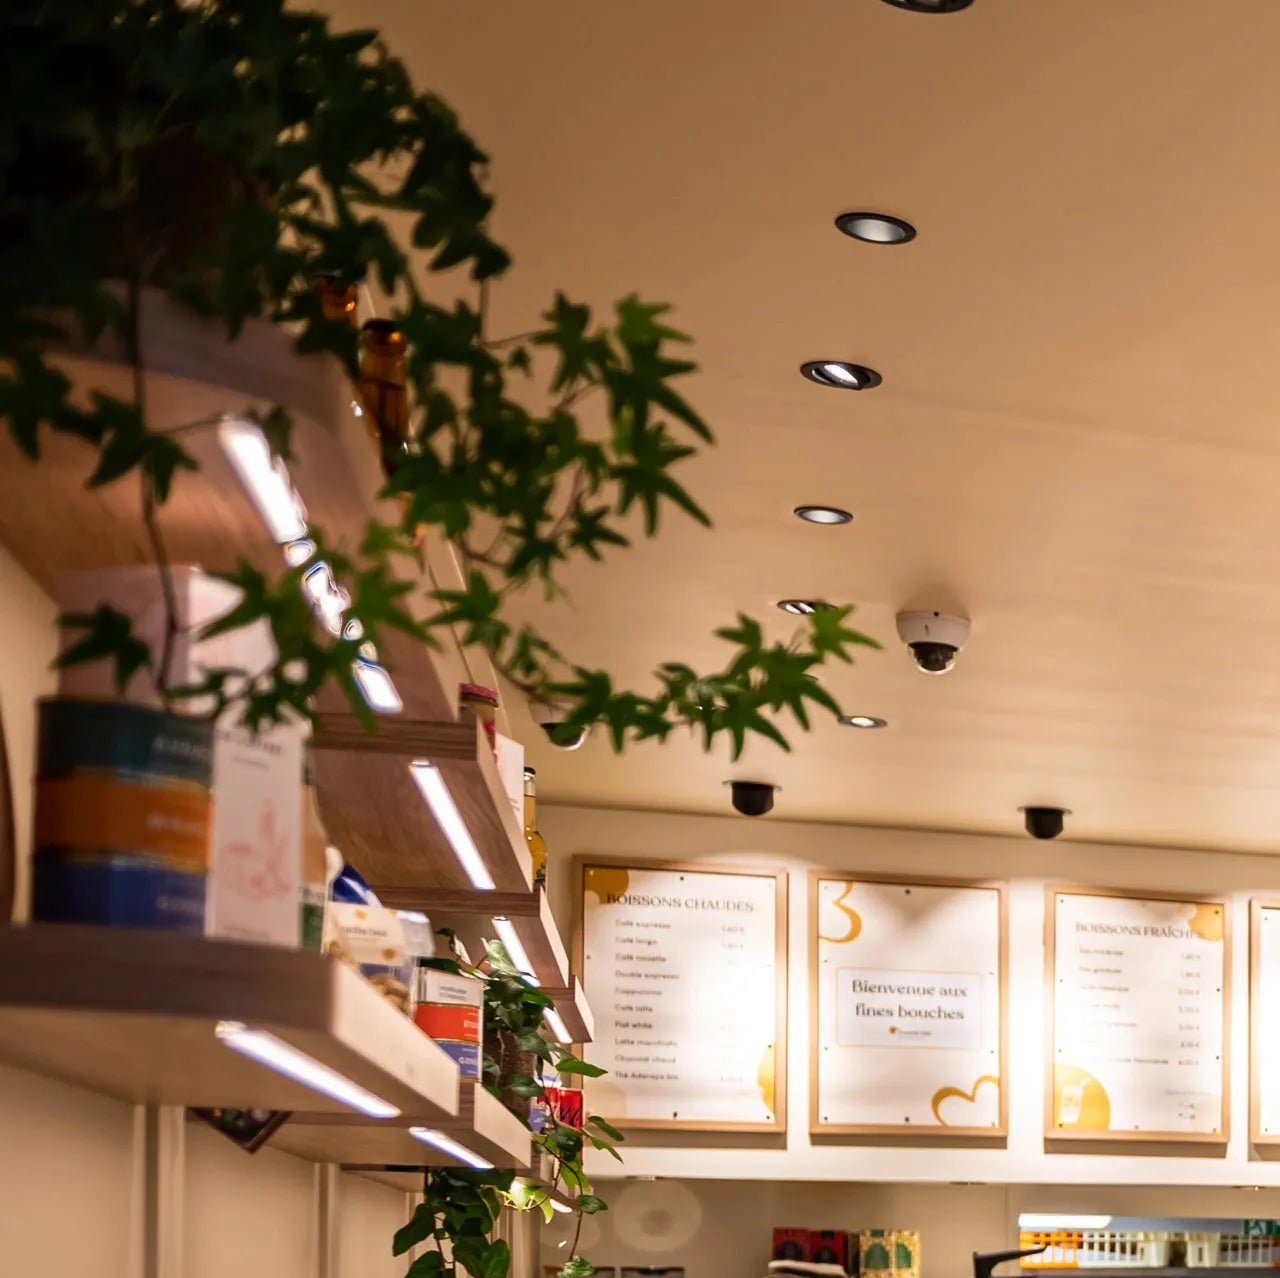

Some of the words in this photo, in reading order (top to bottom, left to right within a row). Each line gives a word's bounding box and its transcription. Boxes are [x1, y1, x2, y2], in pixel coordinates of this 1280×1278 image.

[606, 893, 681, 909] BOISSONS
[684, 898, 754, 912] CHAUDES
[1076, 922, 1142, 936] BOISSONS
[852, 979, 935, 996] Bienvenue
[939, 986, 967, 997] aux
[855, 1002, 894, 1017] fines
[898, 1004, 965, 1020] bouches
